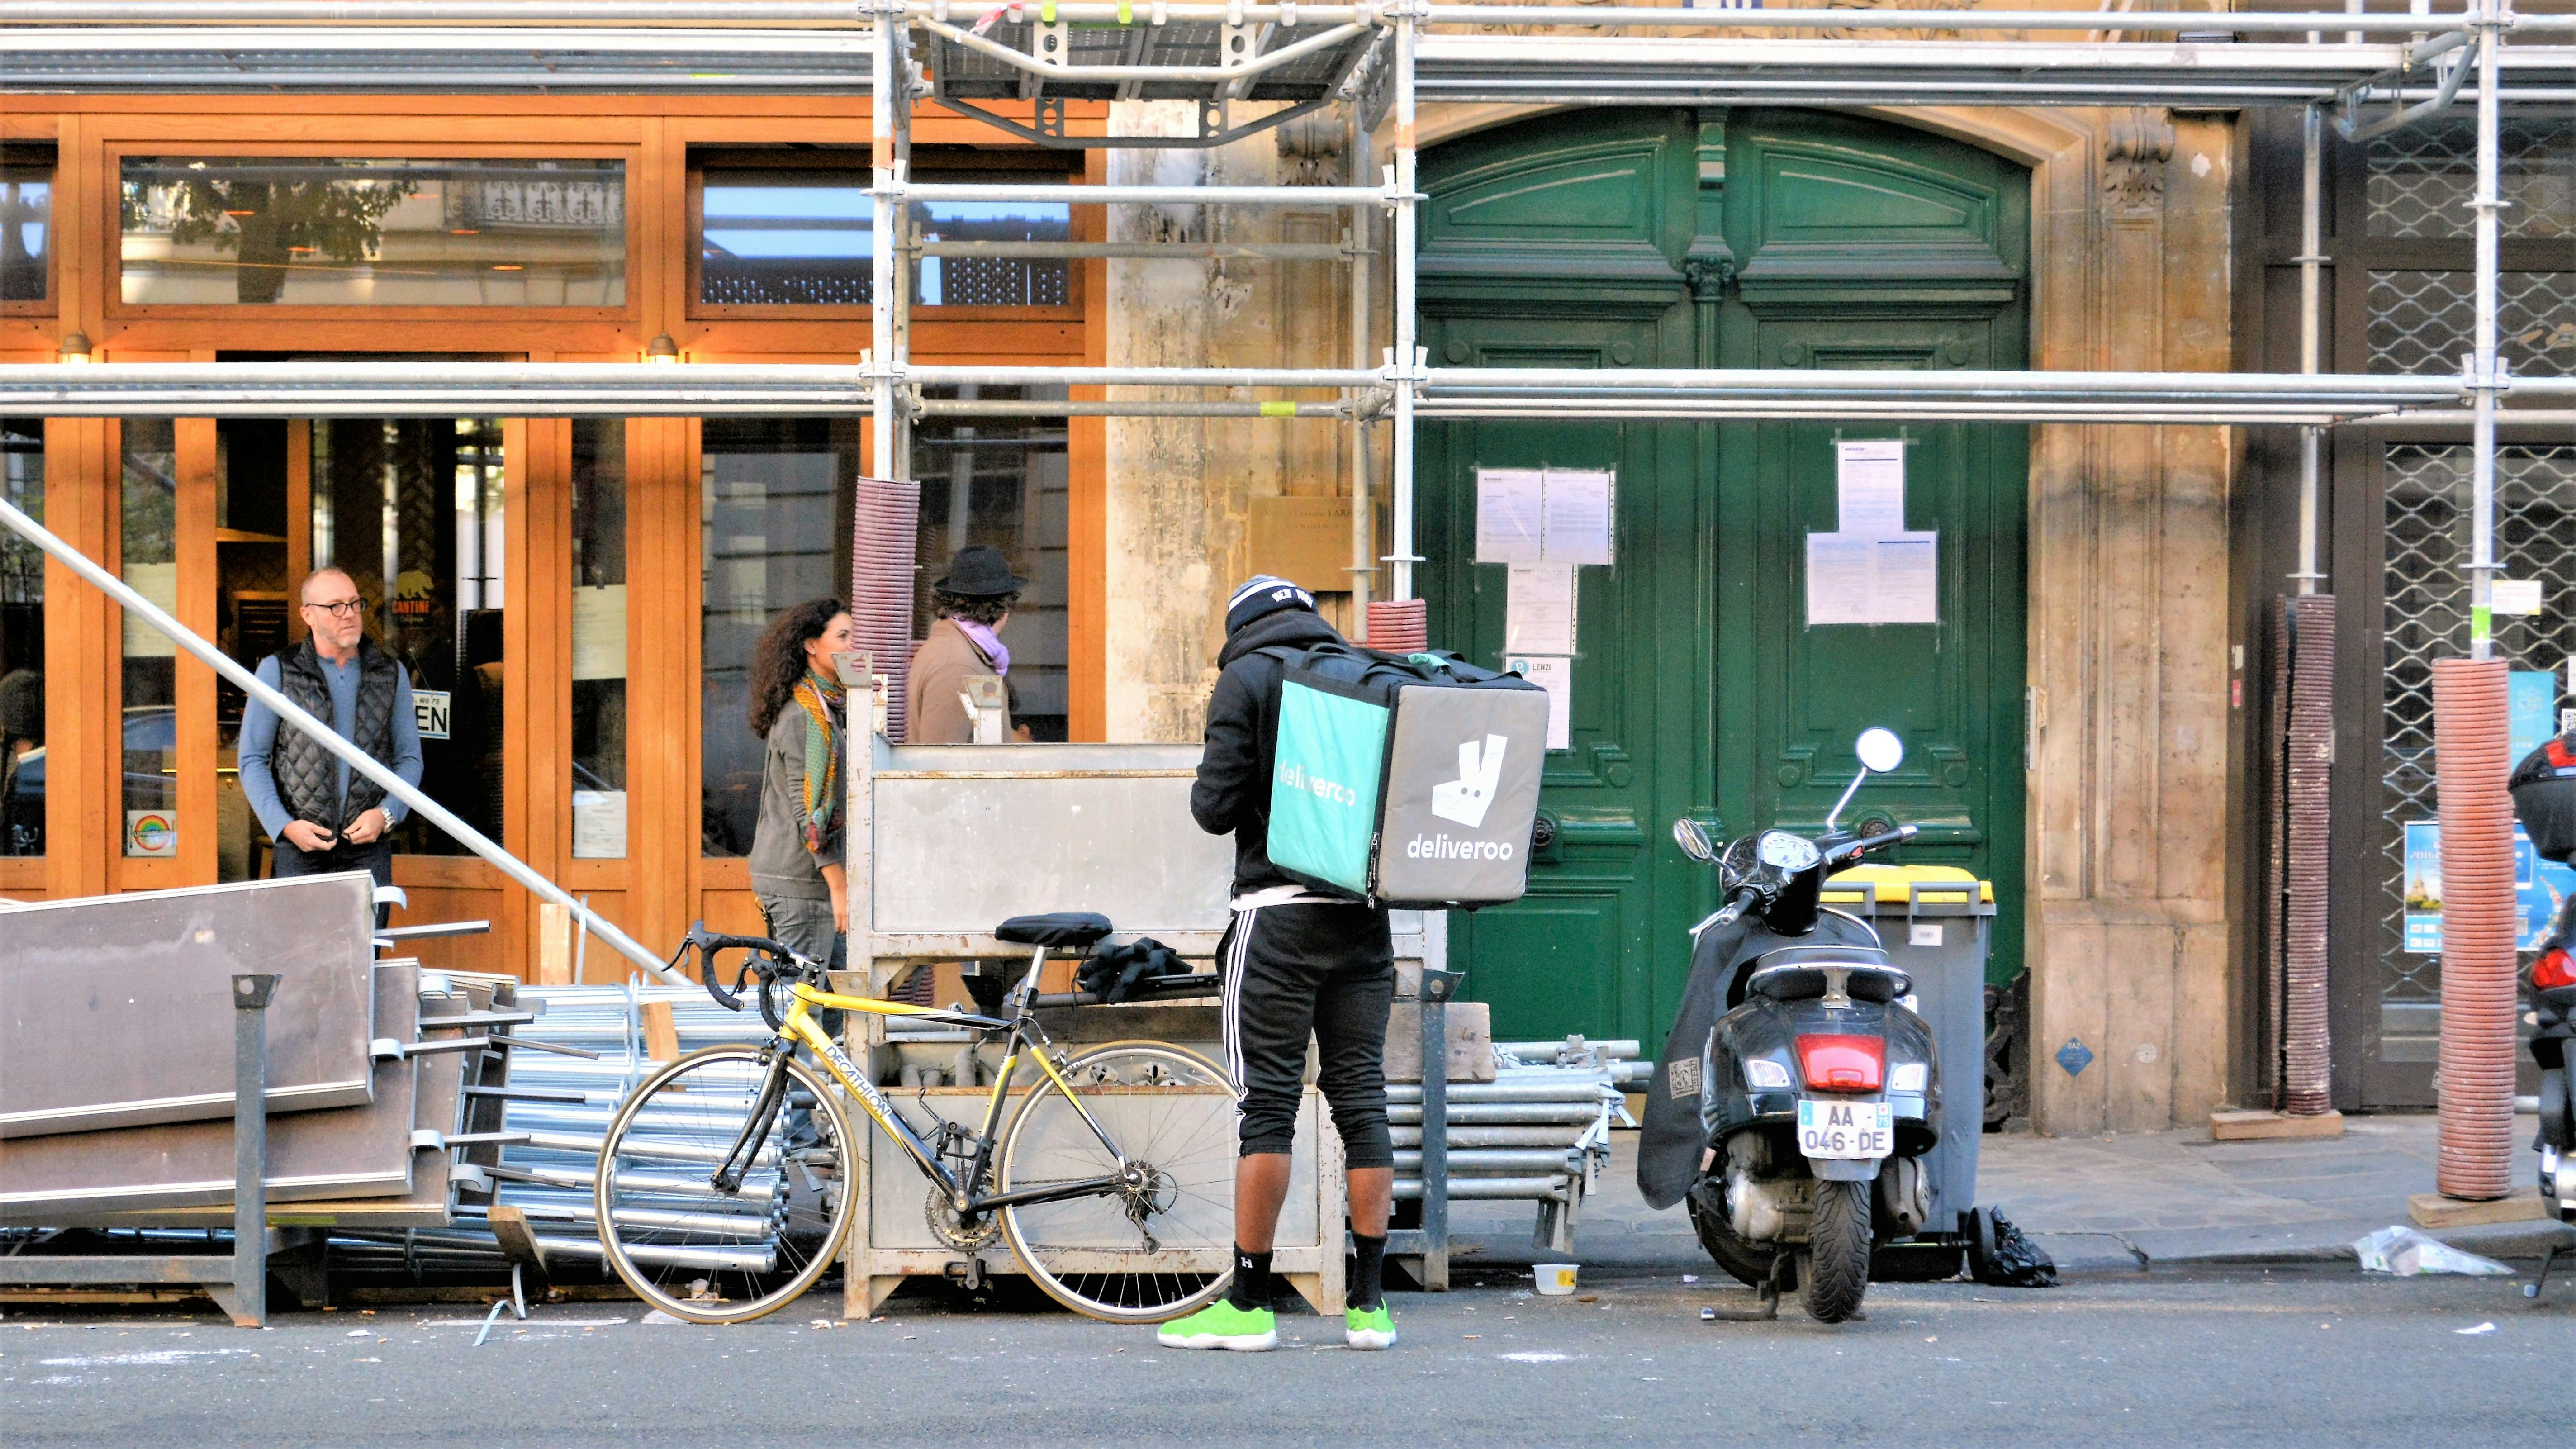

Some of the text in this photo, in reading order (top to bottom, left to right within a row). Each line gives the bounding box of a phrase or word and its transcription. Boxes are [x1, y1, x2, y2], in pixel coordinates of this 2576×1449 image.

[1271, 589, 1313, 608] NEW YORK
[415, 705, 447, 733] EN
[1277, 758, 1356, 807] deliveroo
[1407, 833, 1513, 860] deliveroo
[823, 1045, 891, 1118] DECATHLON
[1828, 1106, 1854, 1126] AA
[1877, 1117, 1890, 1127] 75
